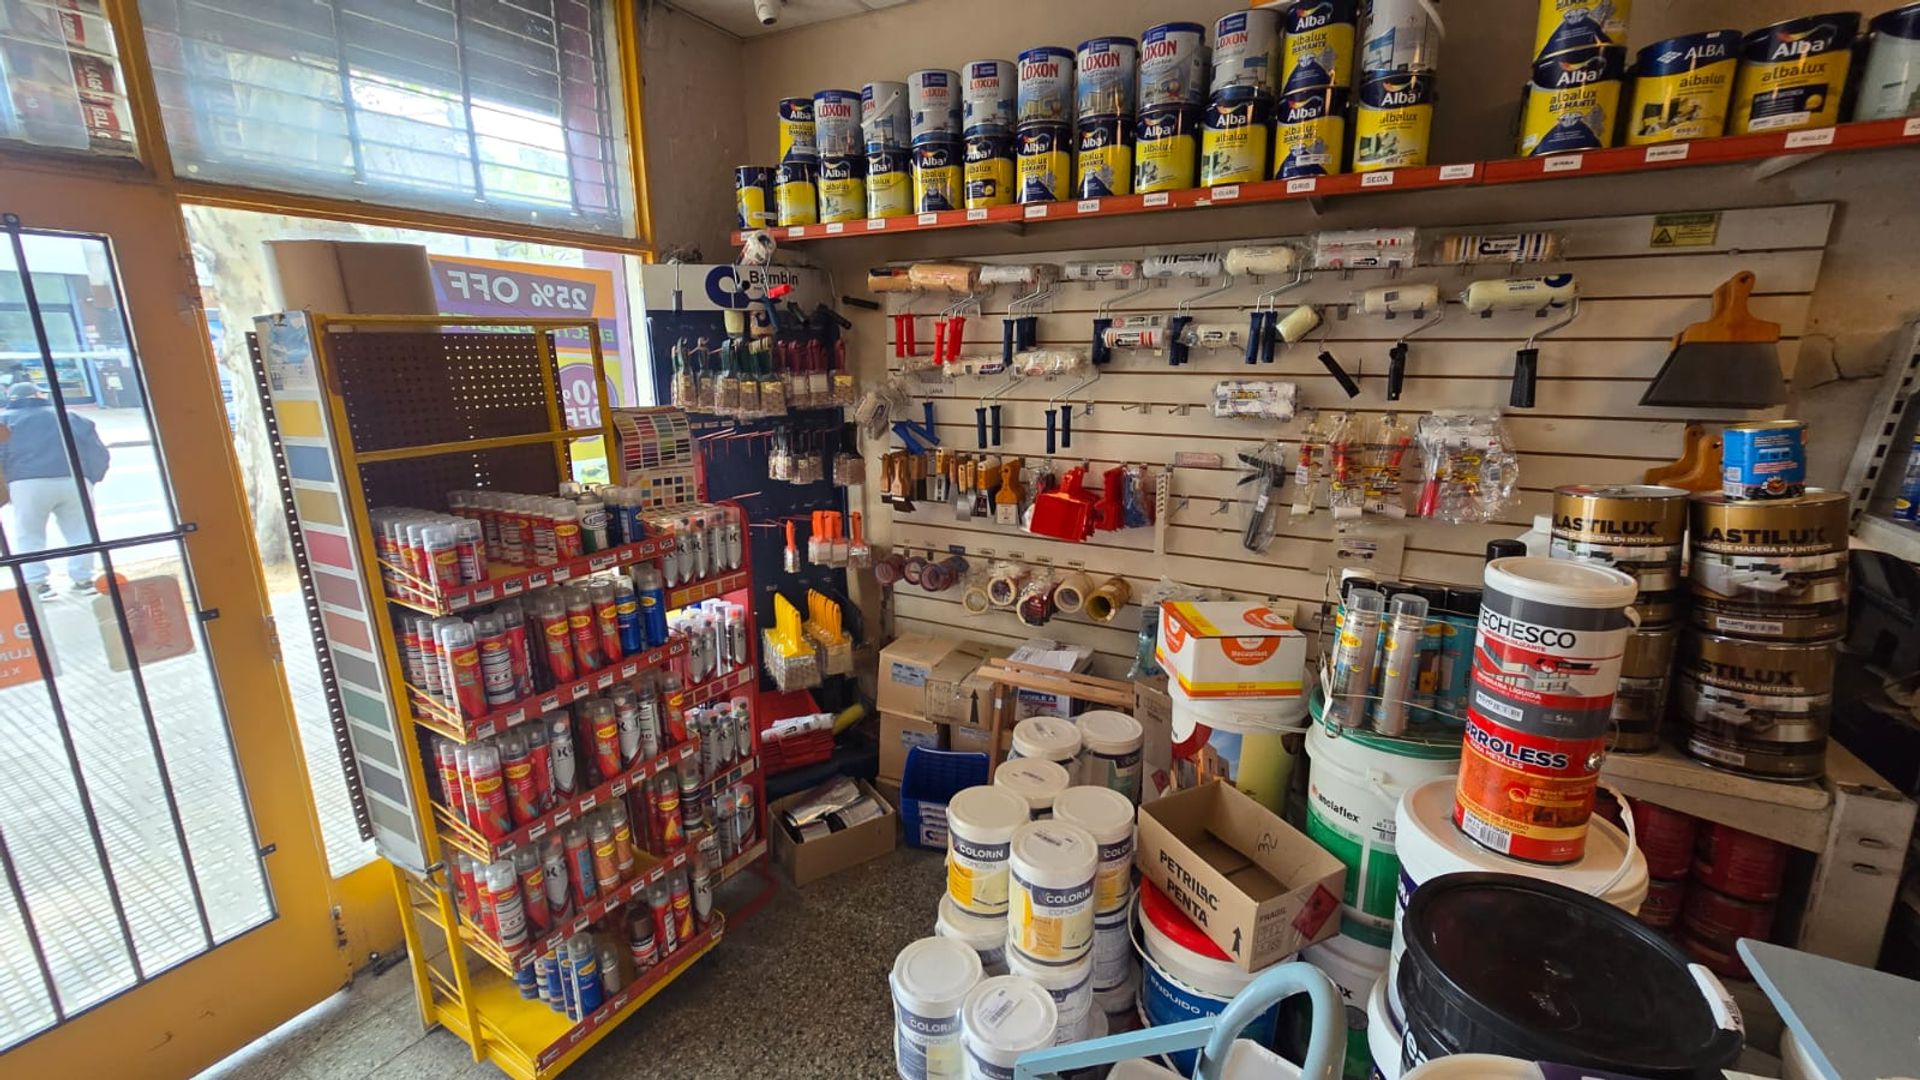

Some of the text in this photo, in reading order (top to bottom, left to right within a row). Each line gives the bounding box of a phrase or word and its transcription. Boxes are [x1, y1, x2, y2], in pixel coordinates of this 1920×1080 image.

[1296, 13, 1325, 31] Alba
[1216, 33, 1248, 50] LOXON
[1142, 40, 1177, 63] LOXON
[1684, 44, 1725, 60] ALBA
[1771, 39, 1824, 60] Alba
[1081, 53, 1120, 72] LOXON
[1022, 64, 1059, 81] LOXON
[1556, 69, 1597, 87] Alba
[1762, 62, 1827, 82] albalux
[970, 79, 999, 90] LOXON
[1679, 73, 1726, 88] albalux
[1381, 91, 1415, 107] Alba
[1550, 90, 1597, 104] albalux
[790, 110, 811, 120] Alba
[818, 104, 850, 118] LOXON
[1288, 107, 1316, 122] Alba
[1380, 112, 1417, 125] albalux
[1216, 114, 1245, 127] Alba
[1144, 124, 1170, 138] Alba
[1216, 132, 1248, 142] albalux
[1024, 141, 1045, 153] Alba
[1082, 135, 1103, 149] Alba
[922, 156, 944, 167] Alba
[825, 167, 847, 178] Alba
[1367, 175, 1389, 184] SEDA
[1735, 545, 1777, 553] MADERA
[1486, 750, 1524, 769] METALES
[1160, 848, 1219, 911] PETRILAC
[1167, 877, 1209, 928] PENTA
[1150, 976, 1201, 1014] ENDUIDO
